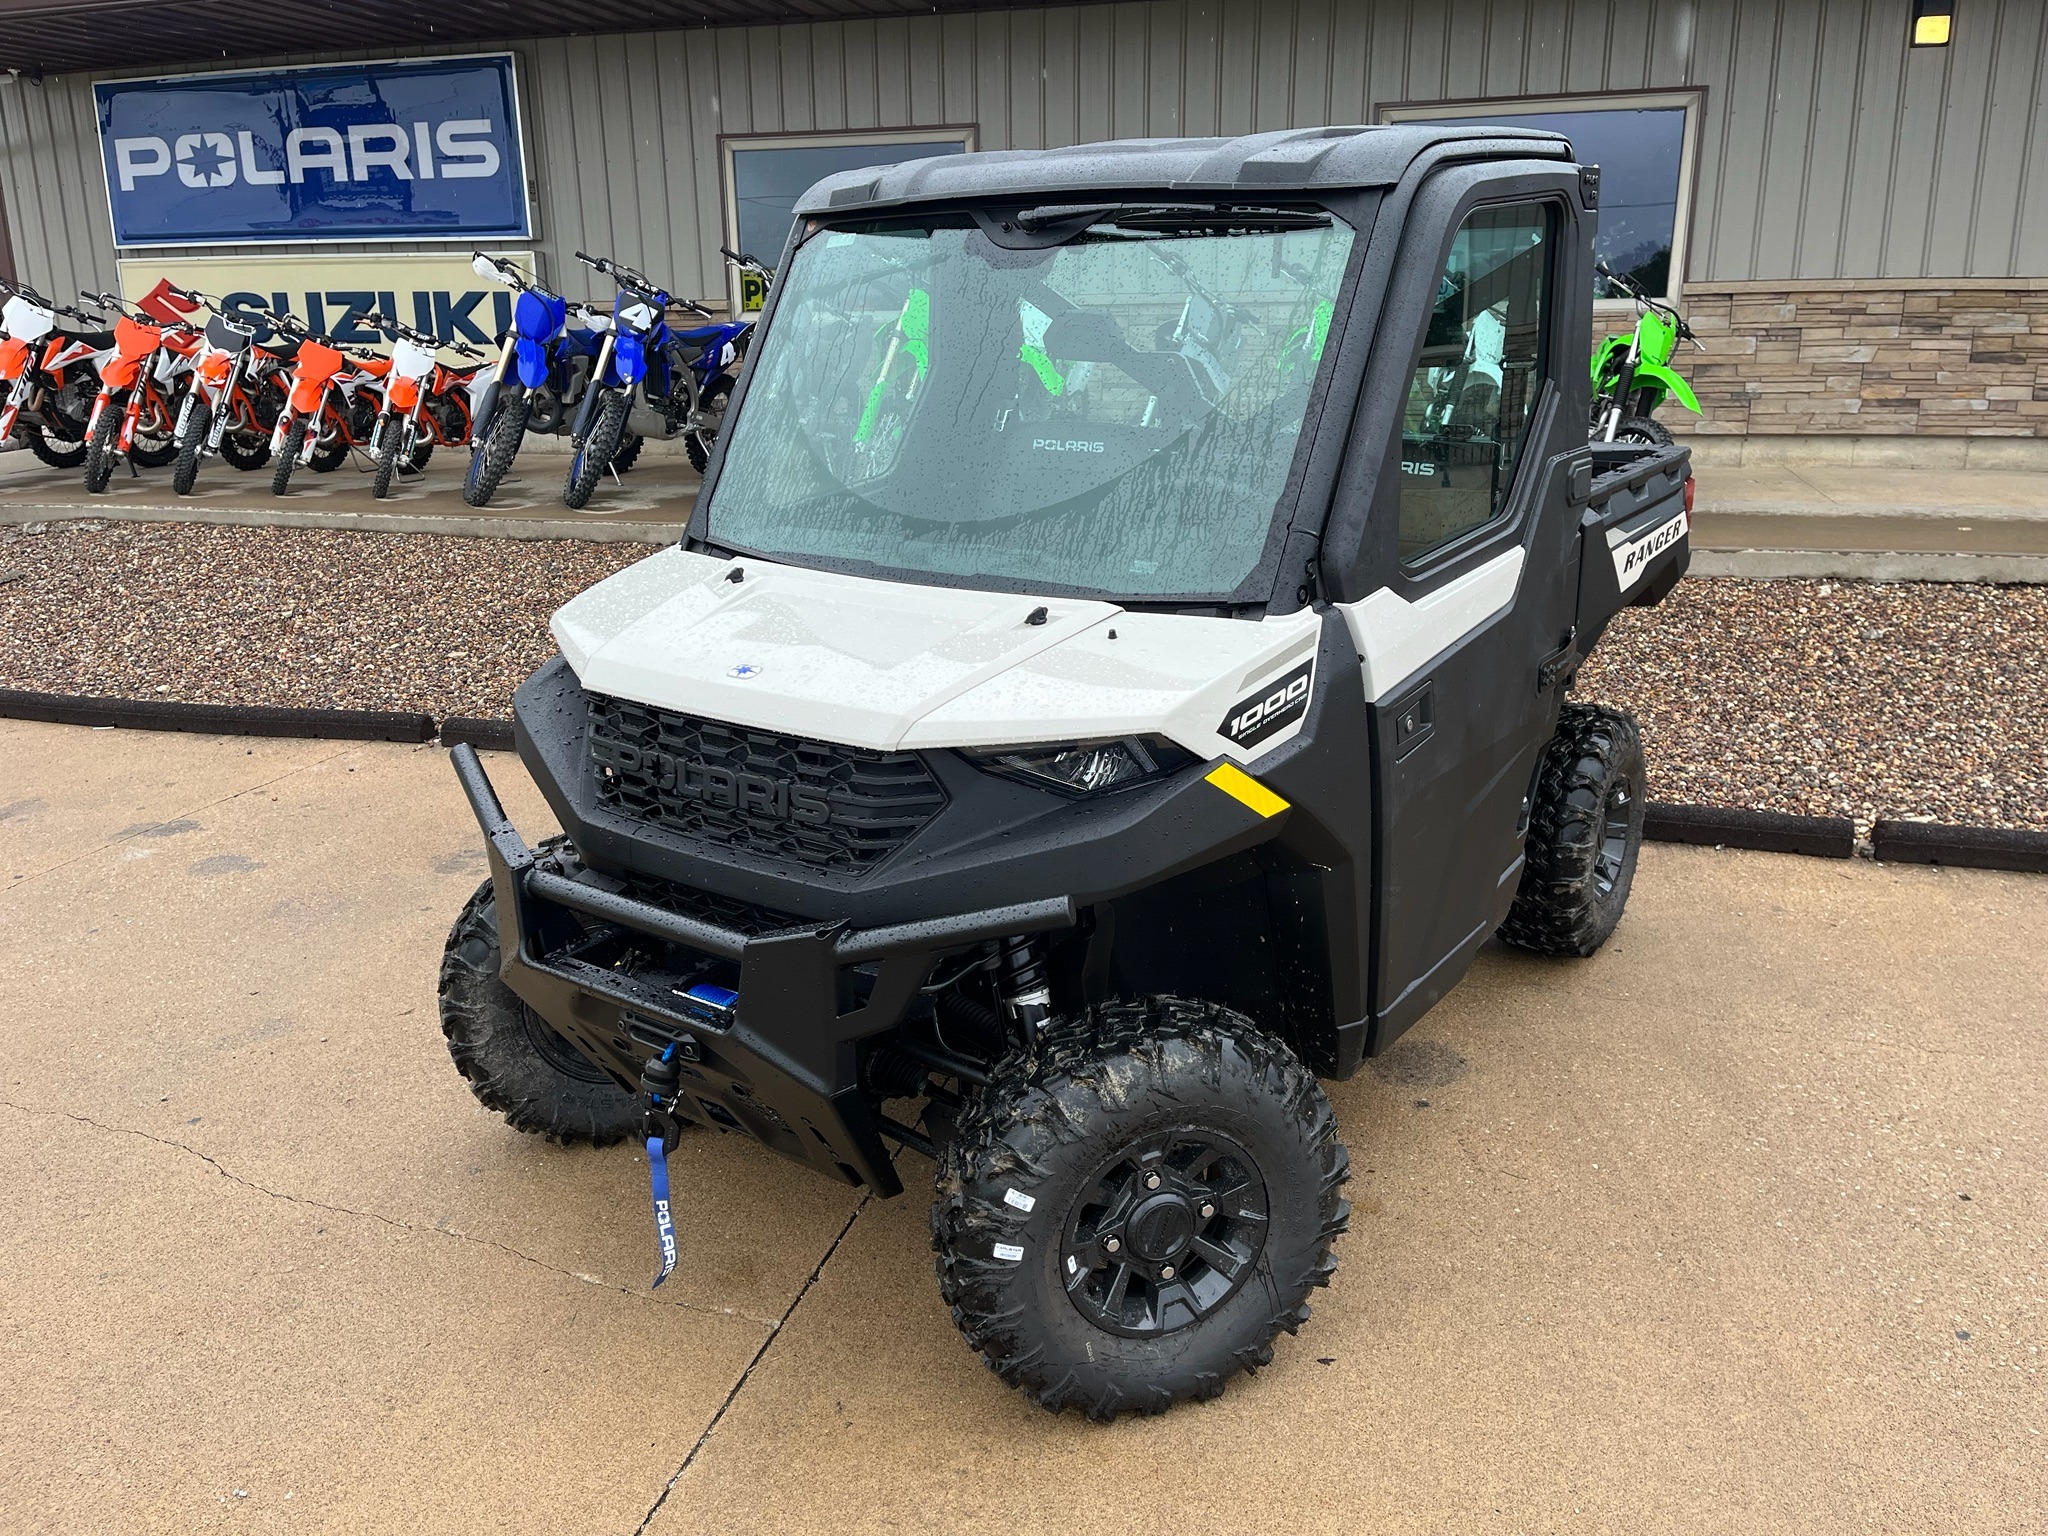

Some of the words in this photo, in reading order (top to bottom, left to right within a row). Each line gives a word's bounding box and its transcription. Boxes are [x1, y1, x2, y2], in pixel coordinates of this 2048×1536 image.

[114, 119, 500, 191] POLARIS
[221, 291, 511, 345] SUZUKI
[619, 302, 658, 331] 4
[720, 341, 737, 367] 4
[1032, 438, 1104, 453] POLARIS
[1623, 518, 1682, 574] RANGER
[1230, 673, 1308, 737] 1000
[1237, 722, 1261, 740] SINGLE
[1262, 701, 1295, 725] OVERHEAD
[609, 745, 831, 825] POLARIS
[655, 1200, 677, 1277] POLARIS
